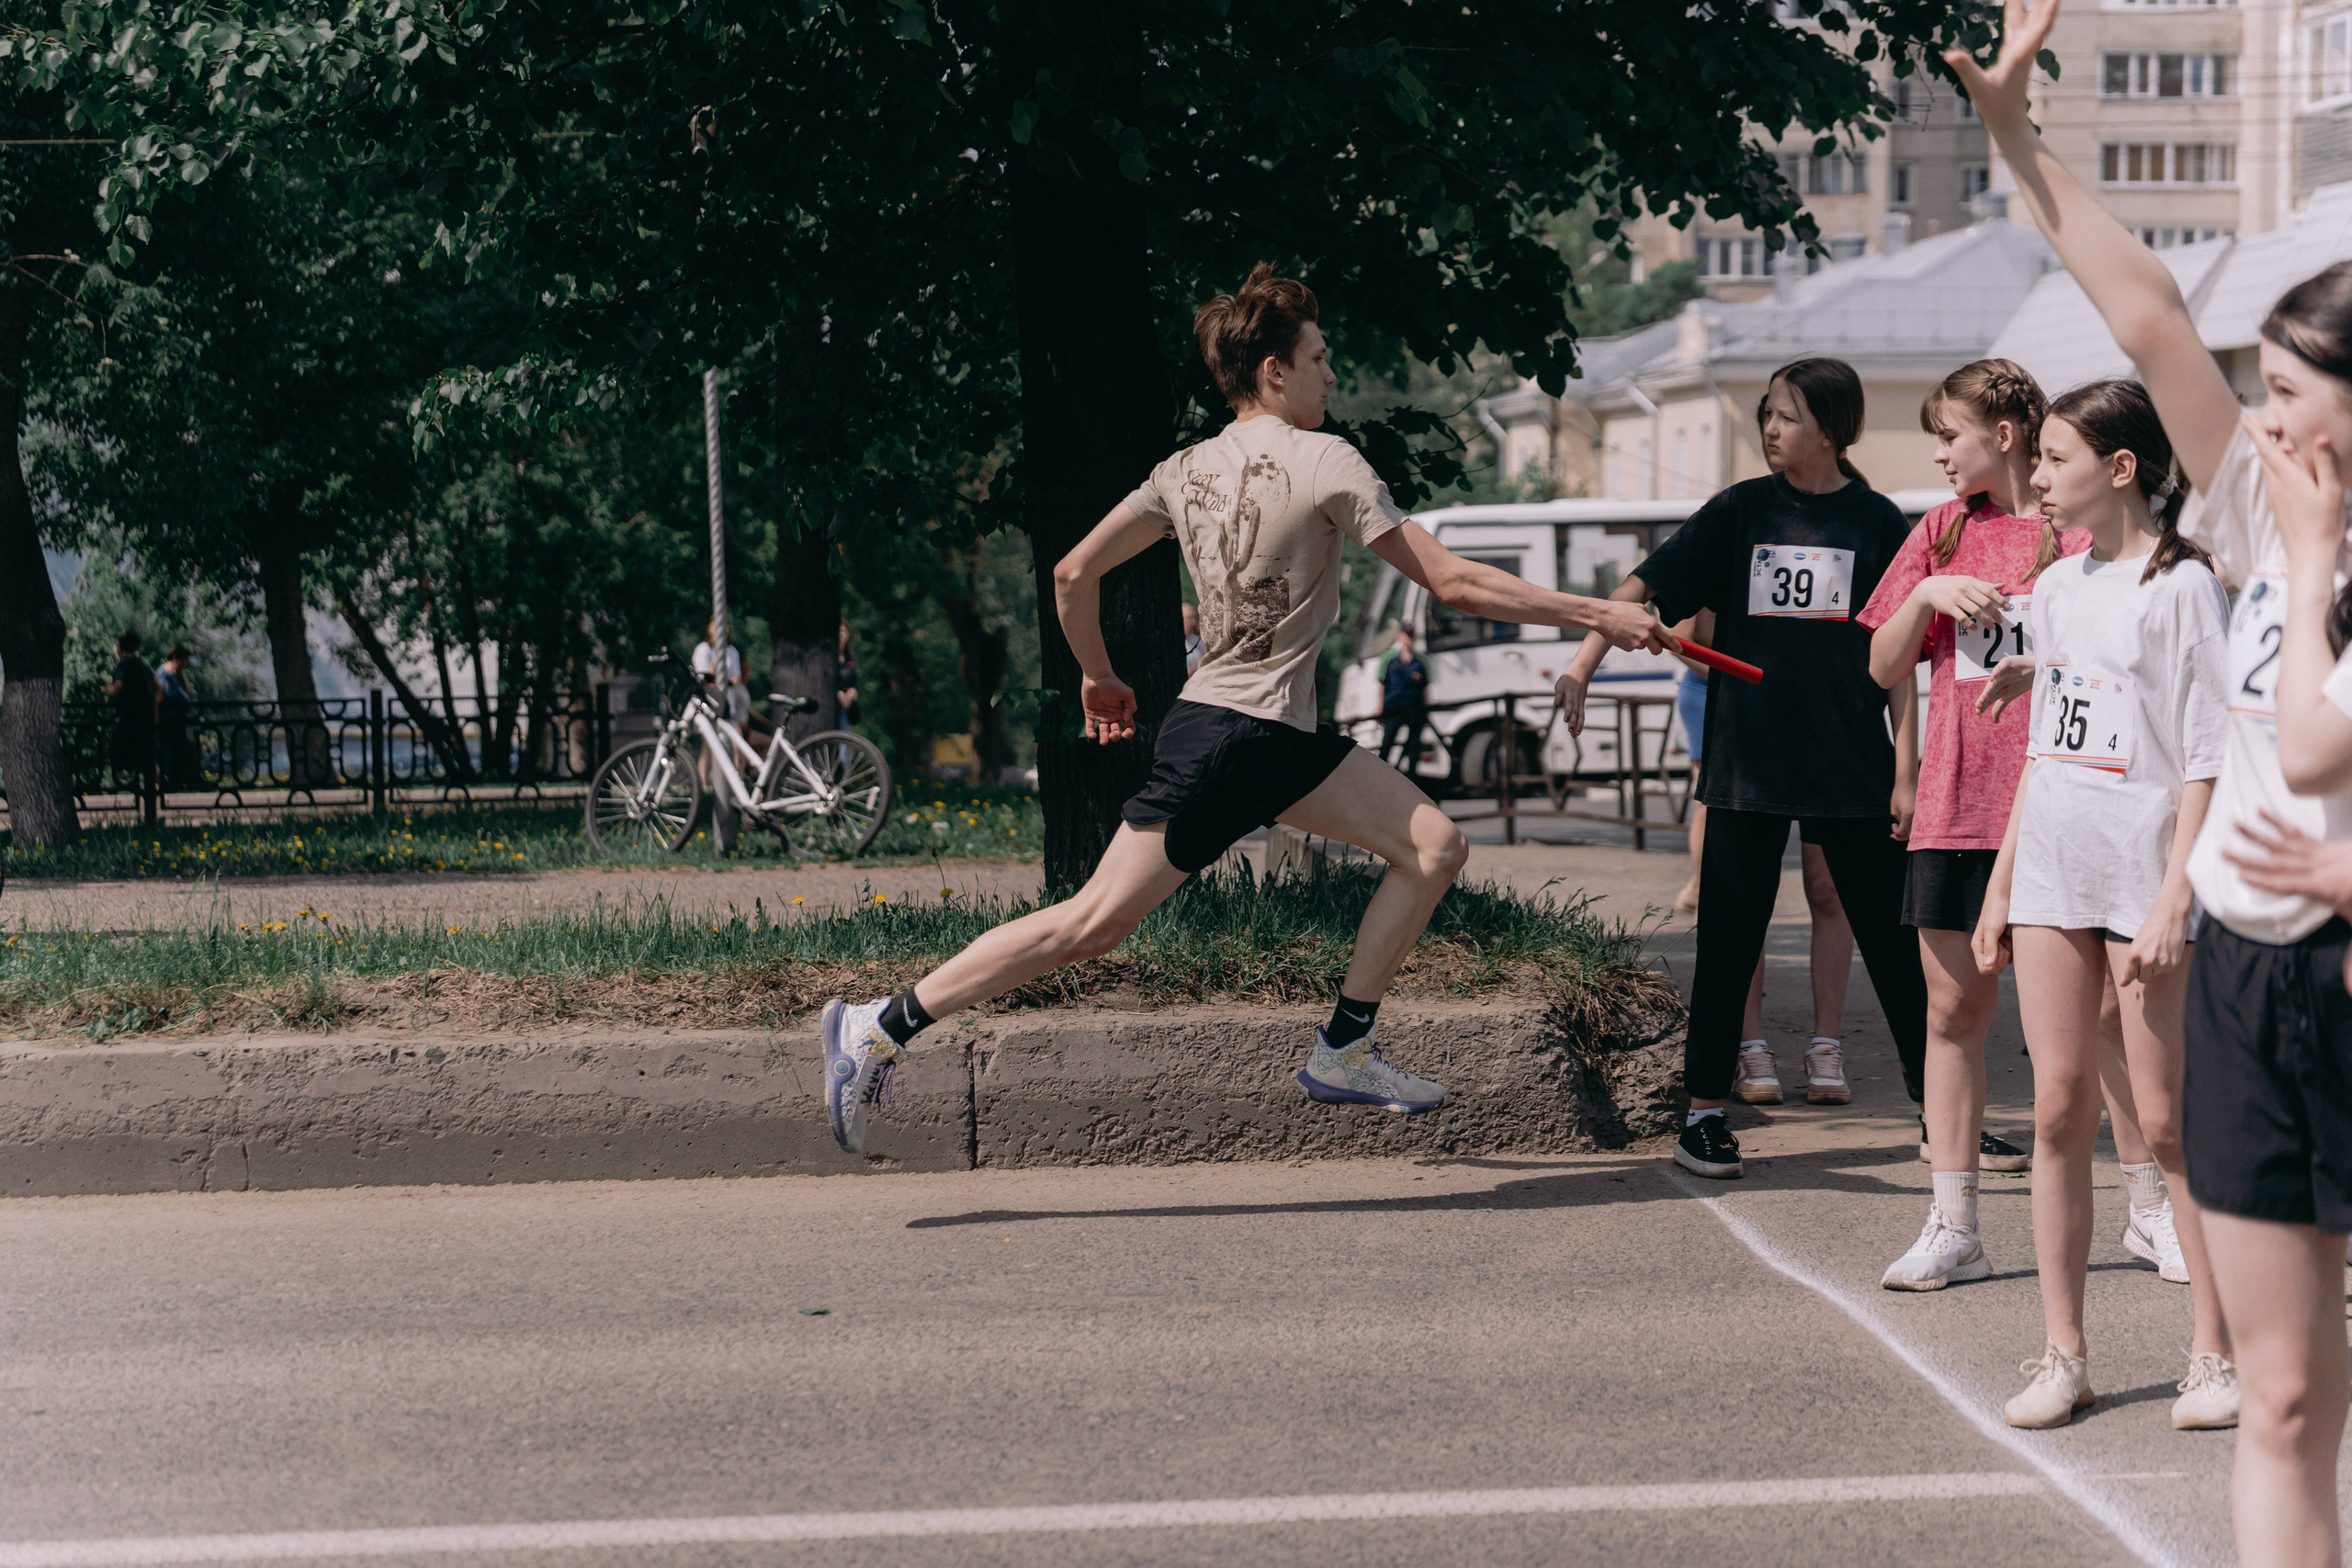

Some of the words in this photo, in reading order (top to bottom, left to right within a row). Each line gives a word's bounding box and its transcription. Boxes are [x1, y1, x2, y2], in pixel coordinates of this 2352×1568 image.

[1771, 567, 1814, 608] 39
[1832, 591, 1839, 605] 4
[1984, 622, 2024, 669] 21
[2054, 695, 2090, 750] 35
[2108, 733, 2117, 751] 4
